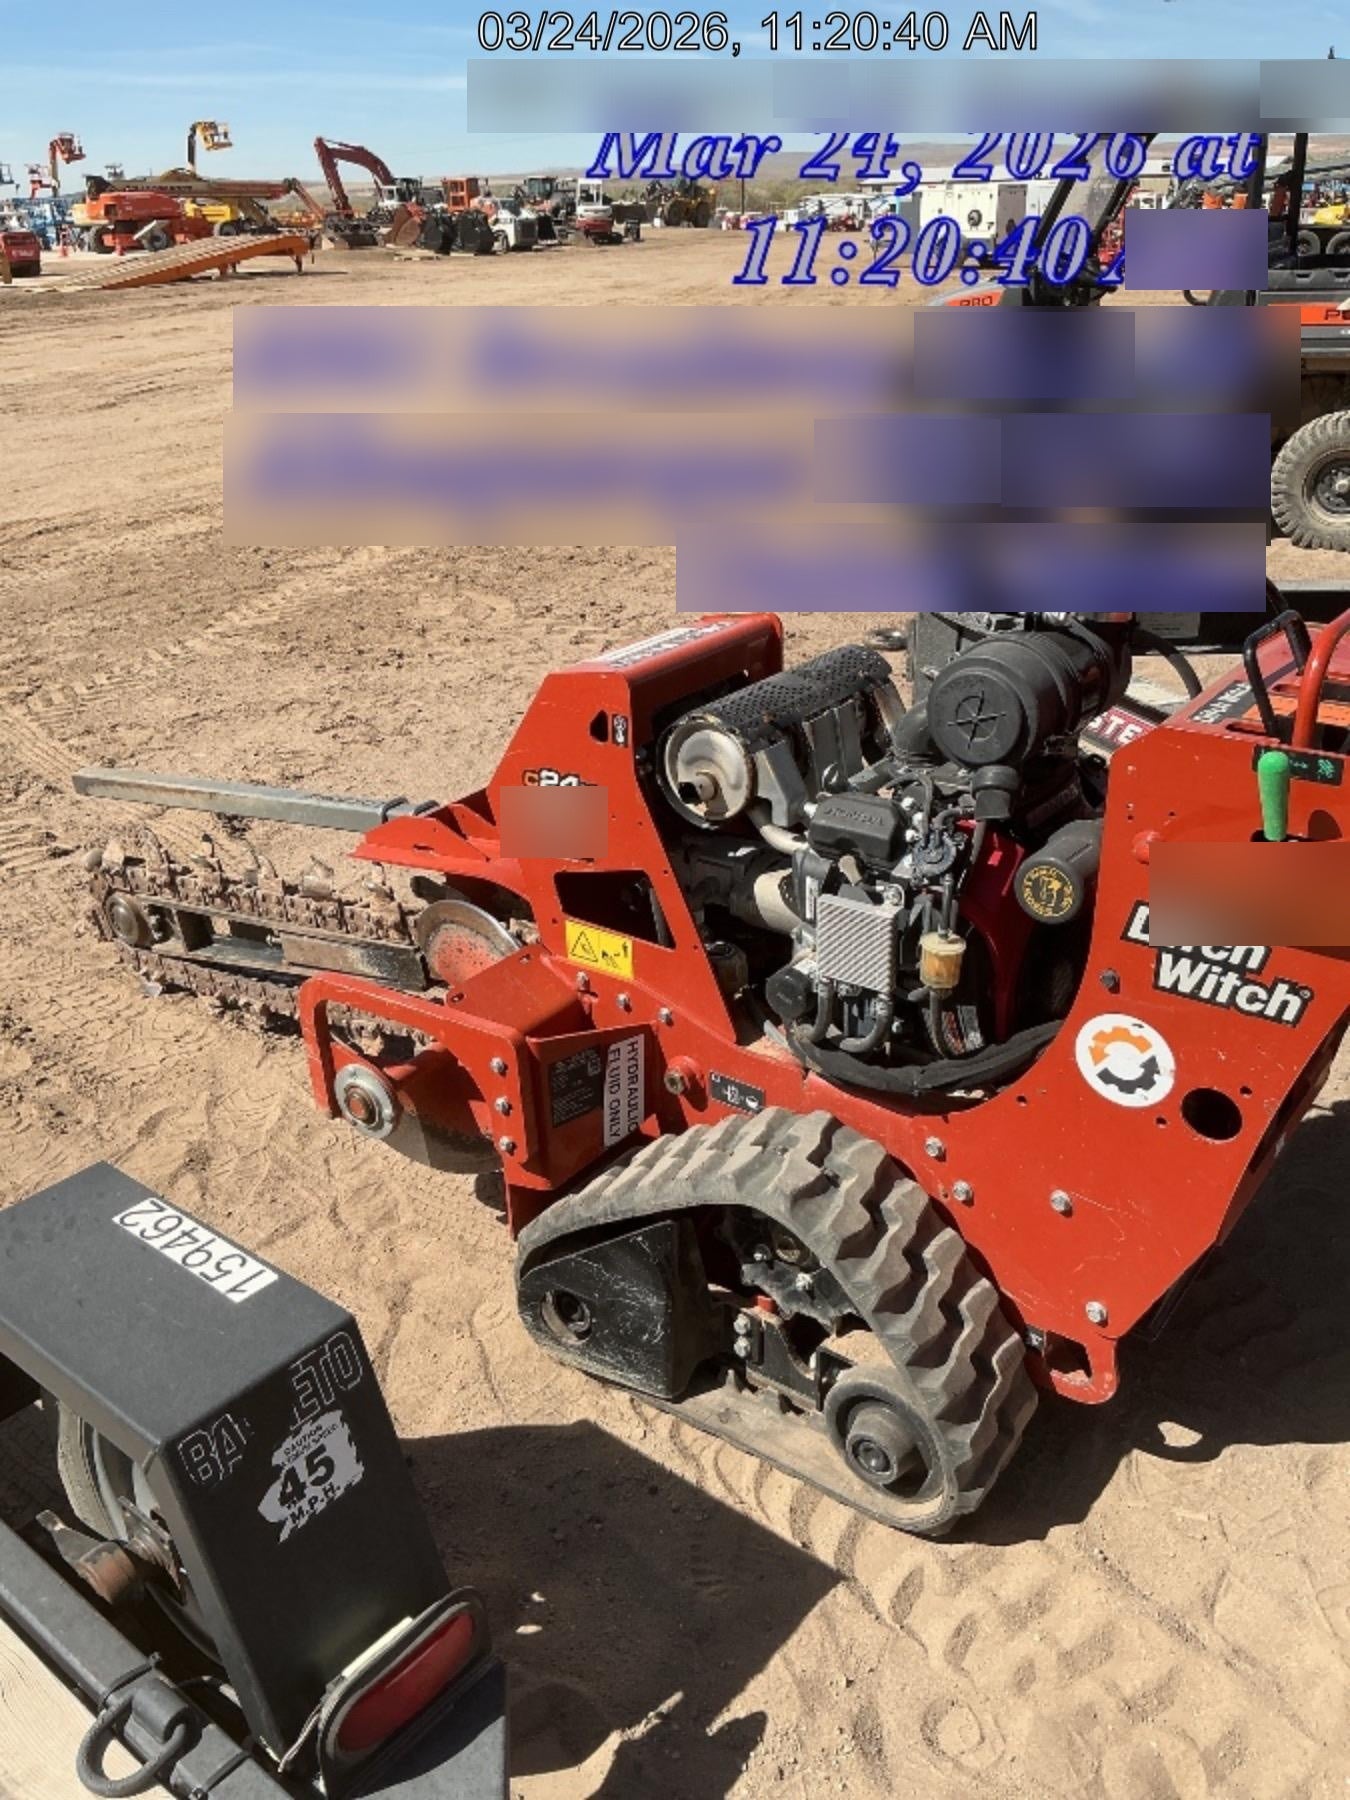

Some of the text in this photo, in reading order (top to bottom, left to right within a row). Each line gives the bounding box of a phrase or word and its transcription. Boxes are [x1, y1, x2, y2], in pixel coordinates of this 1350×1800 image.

[609, 1047, 621, 1139] FLUID ONLY
[626, 1040, 639, 1133] HYDRAULIC
[119, 1199, 266, 1294] 159462
[177, 1331, 363, 1485] BAETO
[278, 1443, 336, 1508] 45
[290, 1481, 341, 1524] M.P.H.
